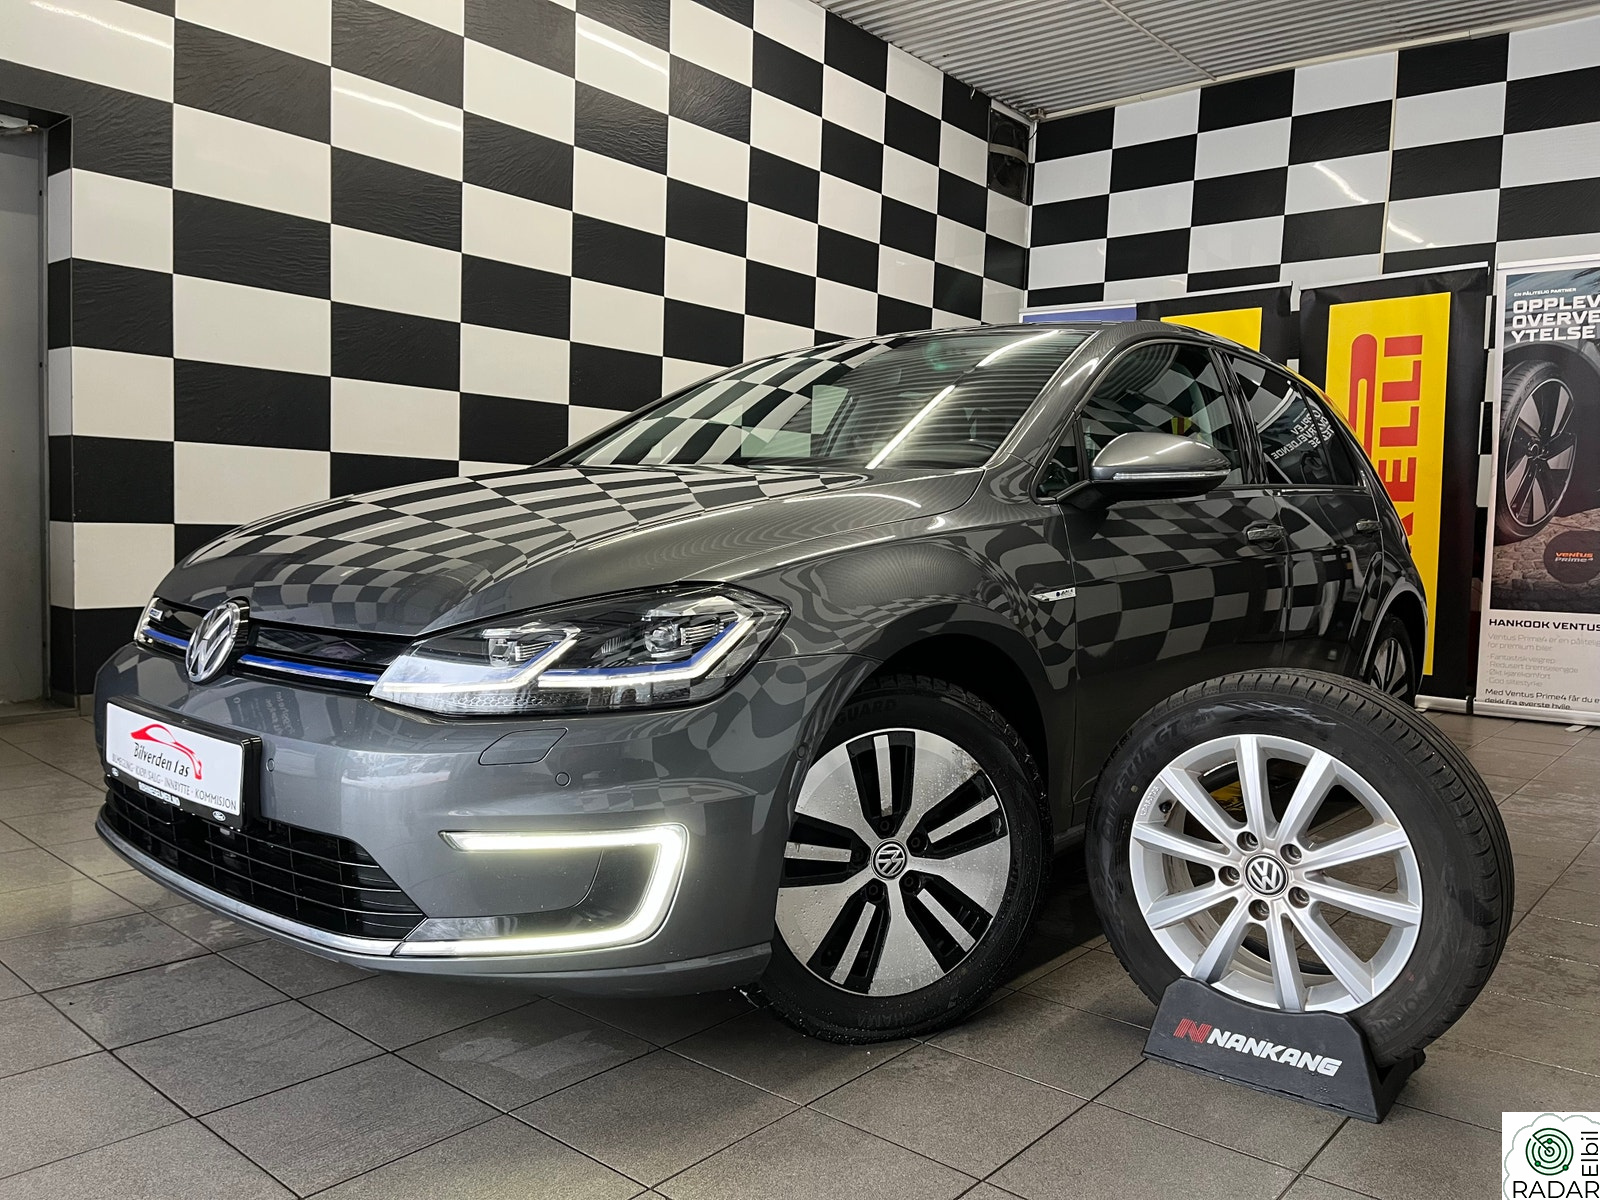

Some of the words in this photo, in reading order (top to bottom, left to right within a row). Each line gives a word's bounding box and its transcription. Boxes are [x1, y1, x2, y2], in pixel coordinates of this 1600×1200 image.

[1513, 294, 1600, 314] OPPLEV
[1511, 325, 1596, 344] YTELSE
[1488, 618, 1550, 628] HANKOOK
[1485, 688, 1504, 696] Med
[1504, 689, 1535, 699] Ventus
[1535, 692, 1567, 701] Prime4
[1568, 694, 1580, 702] får
[1581, 695, 1593, 703] du
[133, 741, 173, 772] Bilverden
[1206, 1028, 1343, 1078] NANKANG
